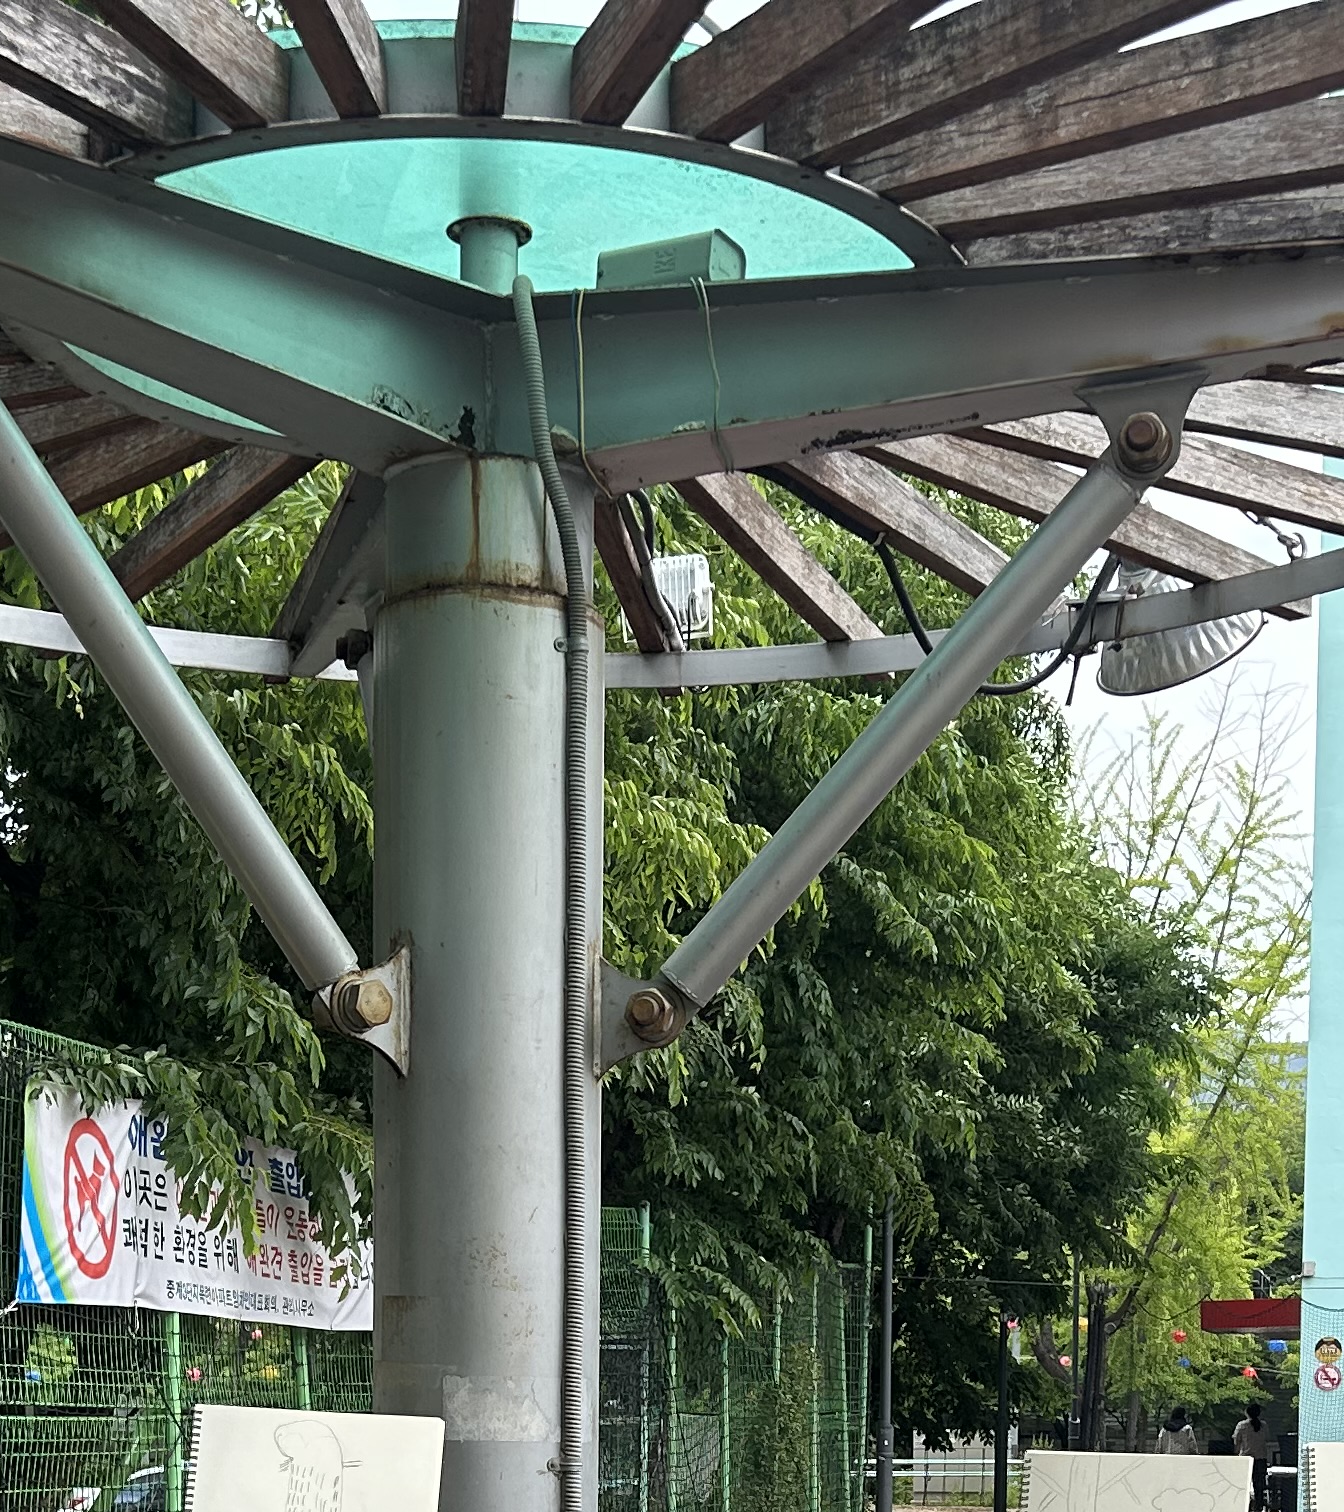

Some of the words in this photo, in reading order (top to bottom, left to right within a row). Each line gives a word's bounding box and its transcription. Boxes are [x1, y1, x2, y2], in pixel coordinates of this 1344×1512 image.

[124, 1165, 168, 1212] 이곳은
[123, 1216, 166, 1260] 쾌적한
[173, 1225, 208, 1269] 환경을
[213, 1235, 240, 1274] 위해
[288, 1249, 325, 1287] 출입을
